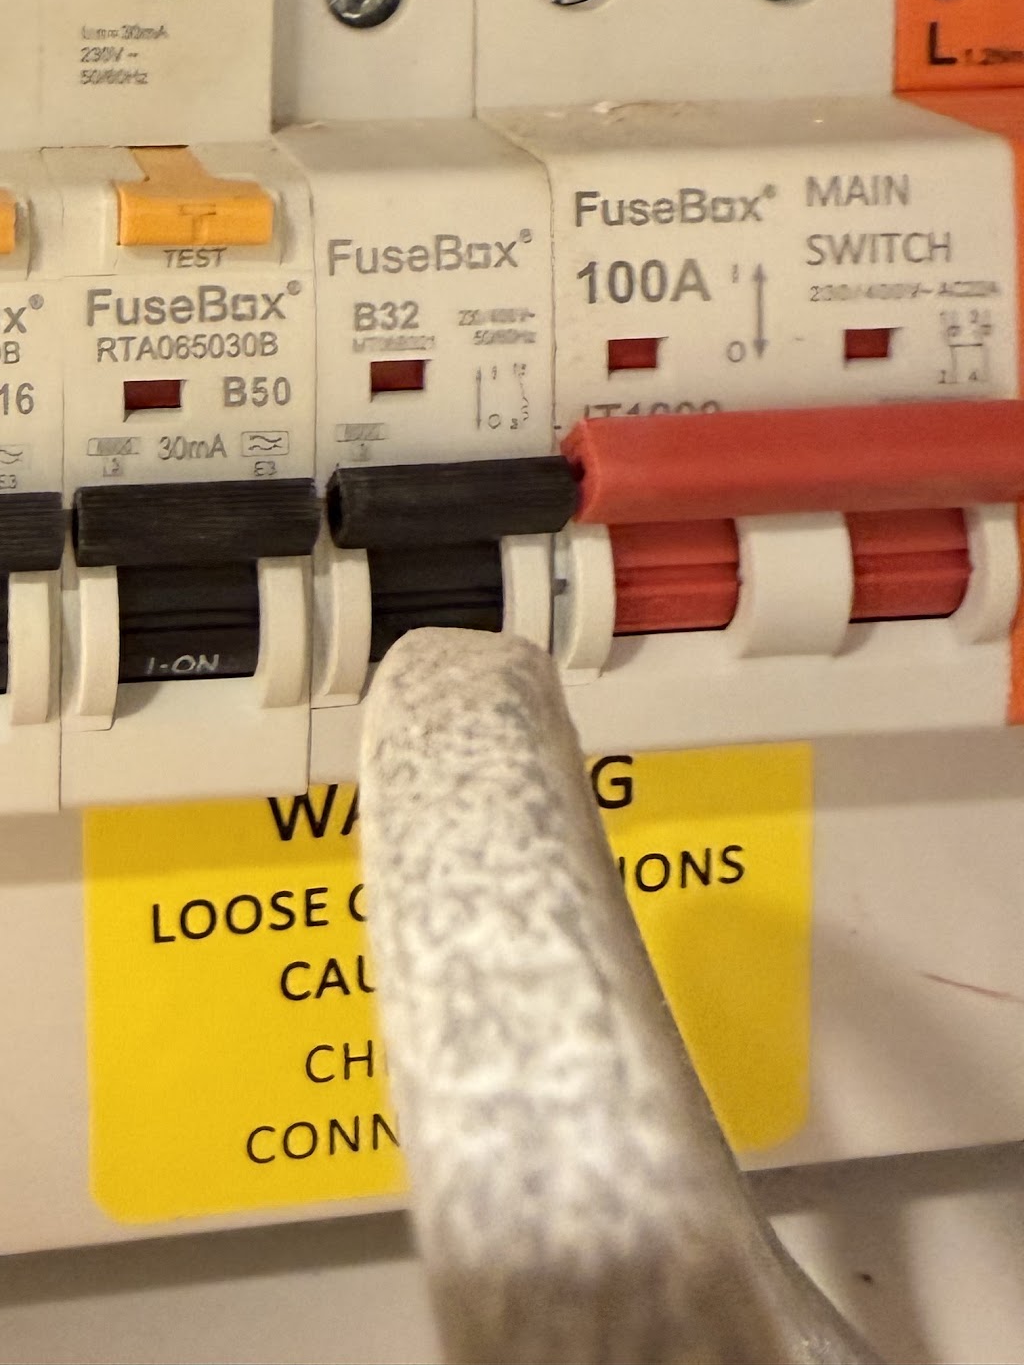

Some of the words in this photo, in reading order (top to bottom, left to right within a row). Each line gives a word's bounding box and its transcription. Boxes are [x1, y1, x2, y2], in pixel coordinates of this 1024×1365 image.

[929, 21, 958, 66] L
[805, 174, 911, 207] MAIN
[164, 247, 227, 268] TEST
[806, 231, 953, 266] SWITCH
[576, 258, 712, 304] 100A
[353, 300, 420, 332] B32
[97, 332, 279, 363] RTA065030B
[224, 376, 291, 408] B50
[158, 434, 227, 460] 30mA
[152, 886, 330, 944] LOOSE
[246, 1112, 401, 1164] CONN
